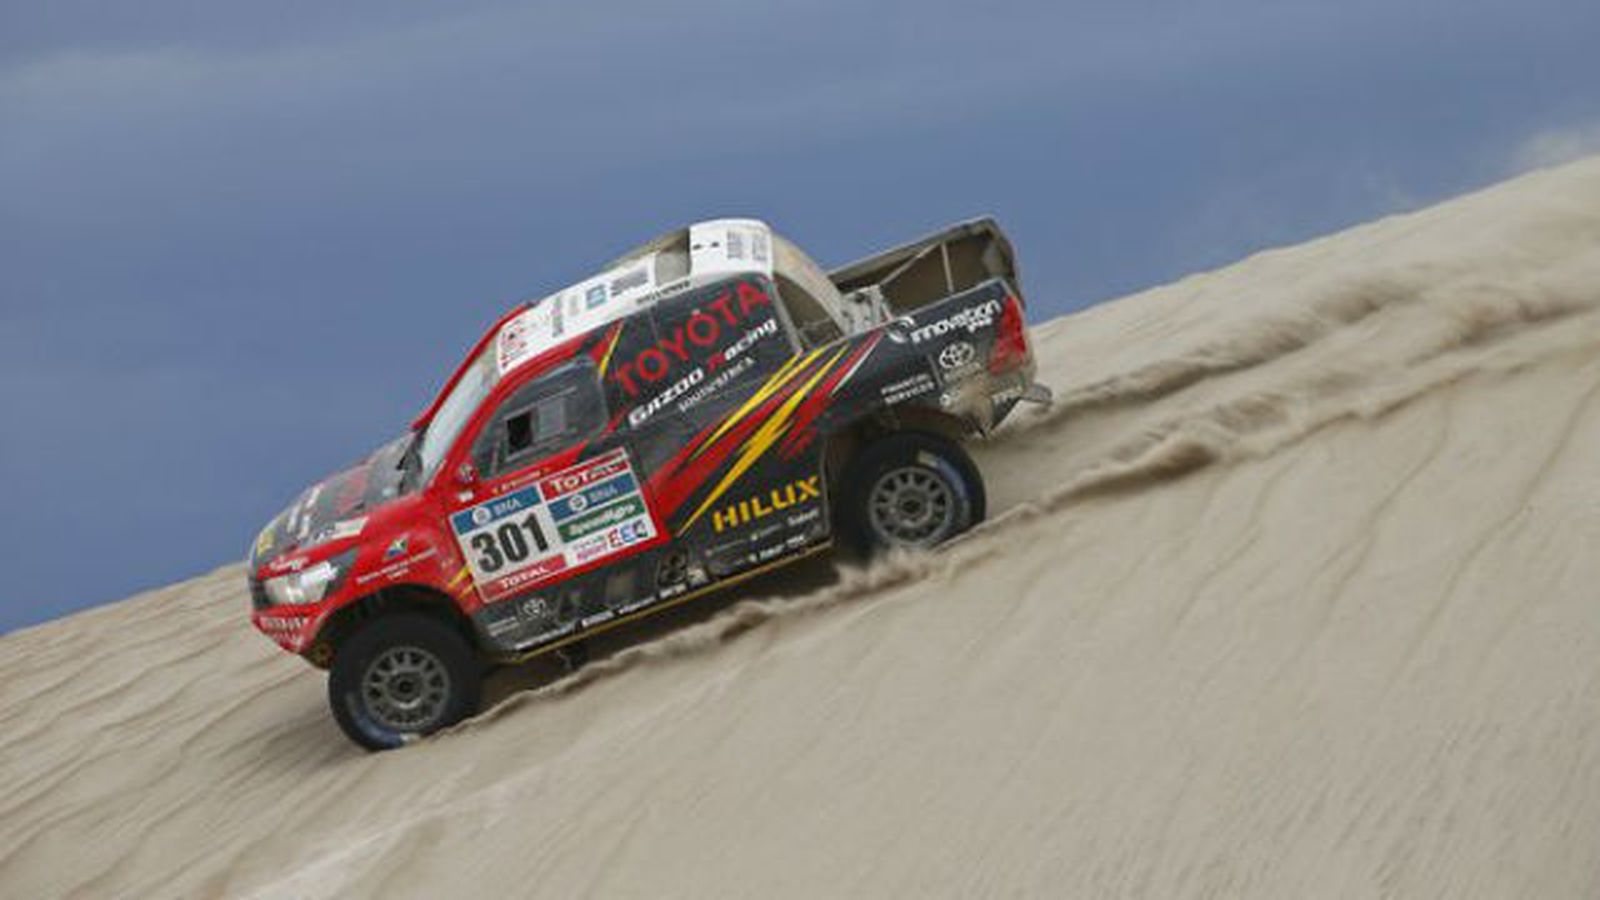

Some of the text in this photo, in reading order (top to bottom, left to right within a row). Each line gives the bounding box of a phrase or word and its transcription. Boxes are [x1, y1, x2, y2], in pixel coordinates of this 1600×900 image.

[613, 281, 770, 397] TOYOTA
[628, 367, 704, 429] GAZOO
[713, 475, 821, 534] HILUX
[471, 513, 549, 573] 301
[501, 566, 550, 589] TOTAL
